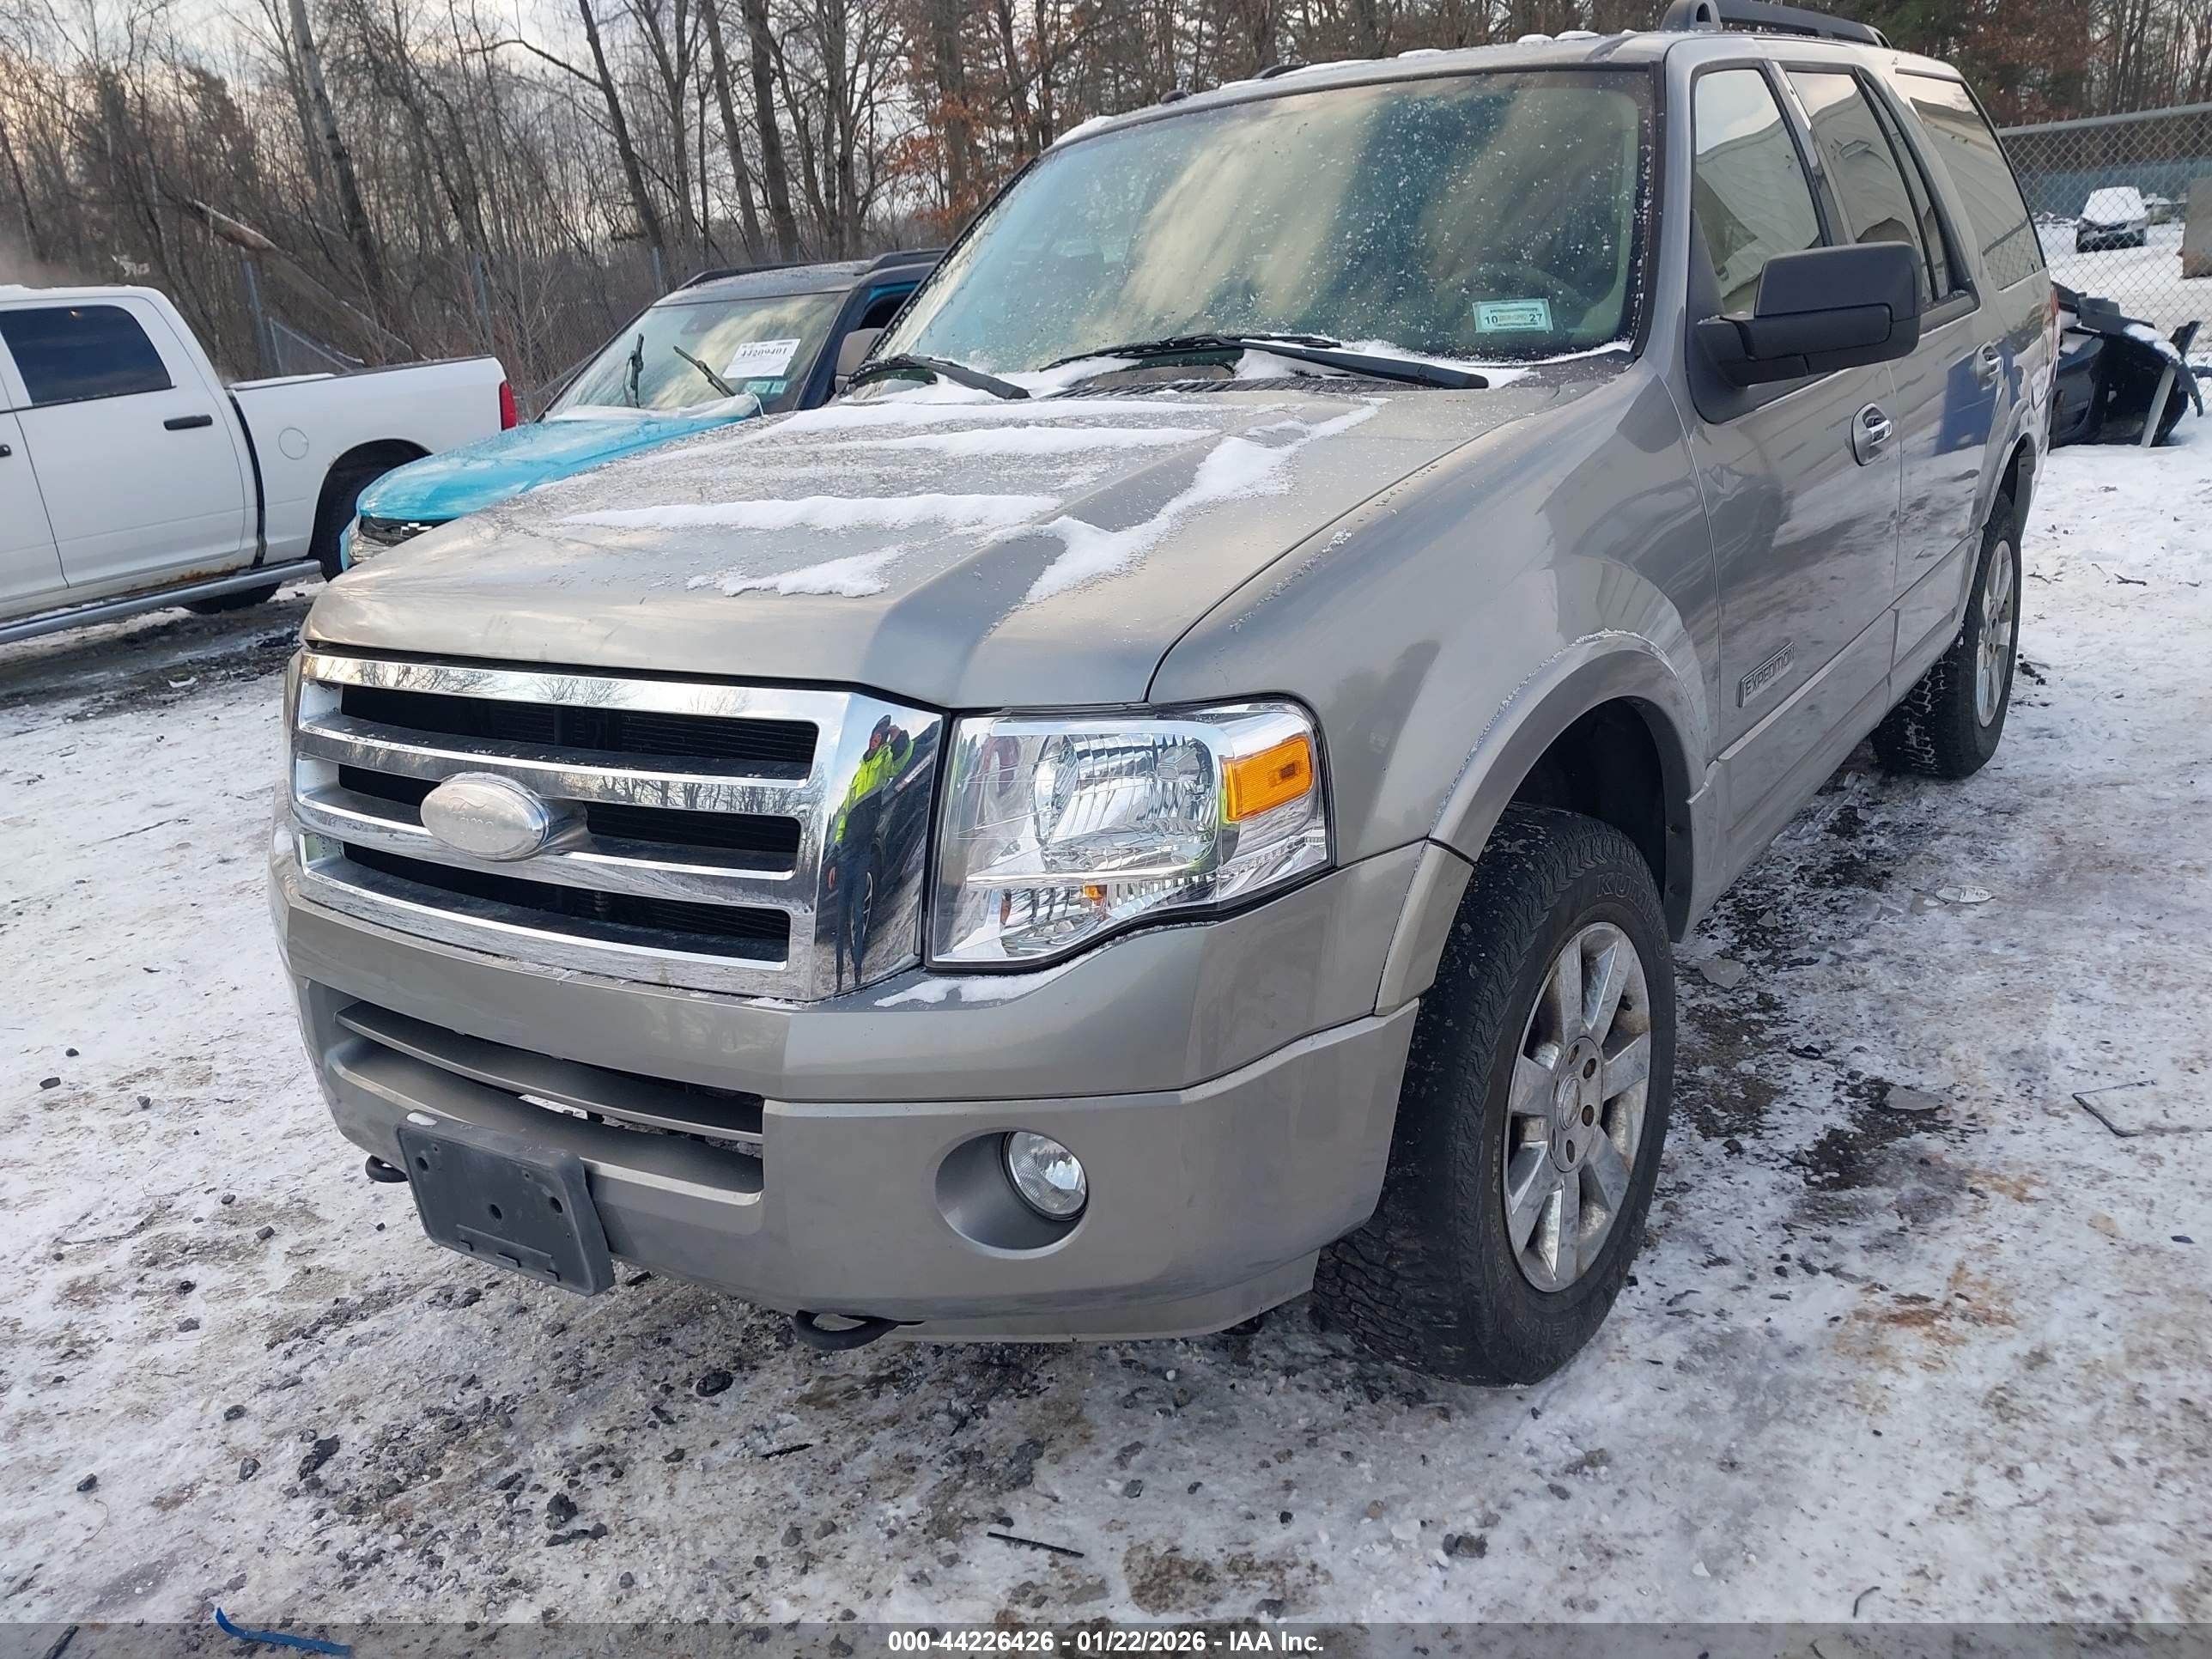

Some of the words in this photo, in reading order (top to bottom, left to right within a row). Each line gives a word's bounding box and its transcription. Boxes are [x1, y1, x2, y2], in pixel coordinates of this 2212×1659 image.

[1485, 315, 1498, 325] 10
[1529, 313, 1543, 323] 27
[1745, 645, 1794, 696] EXPEDITION
[1595, 872, 1668, 960] KUMHO
